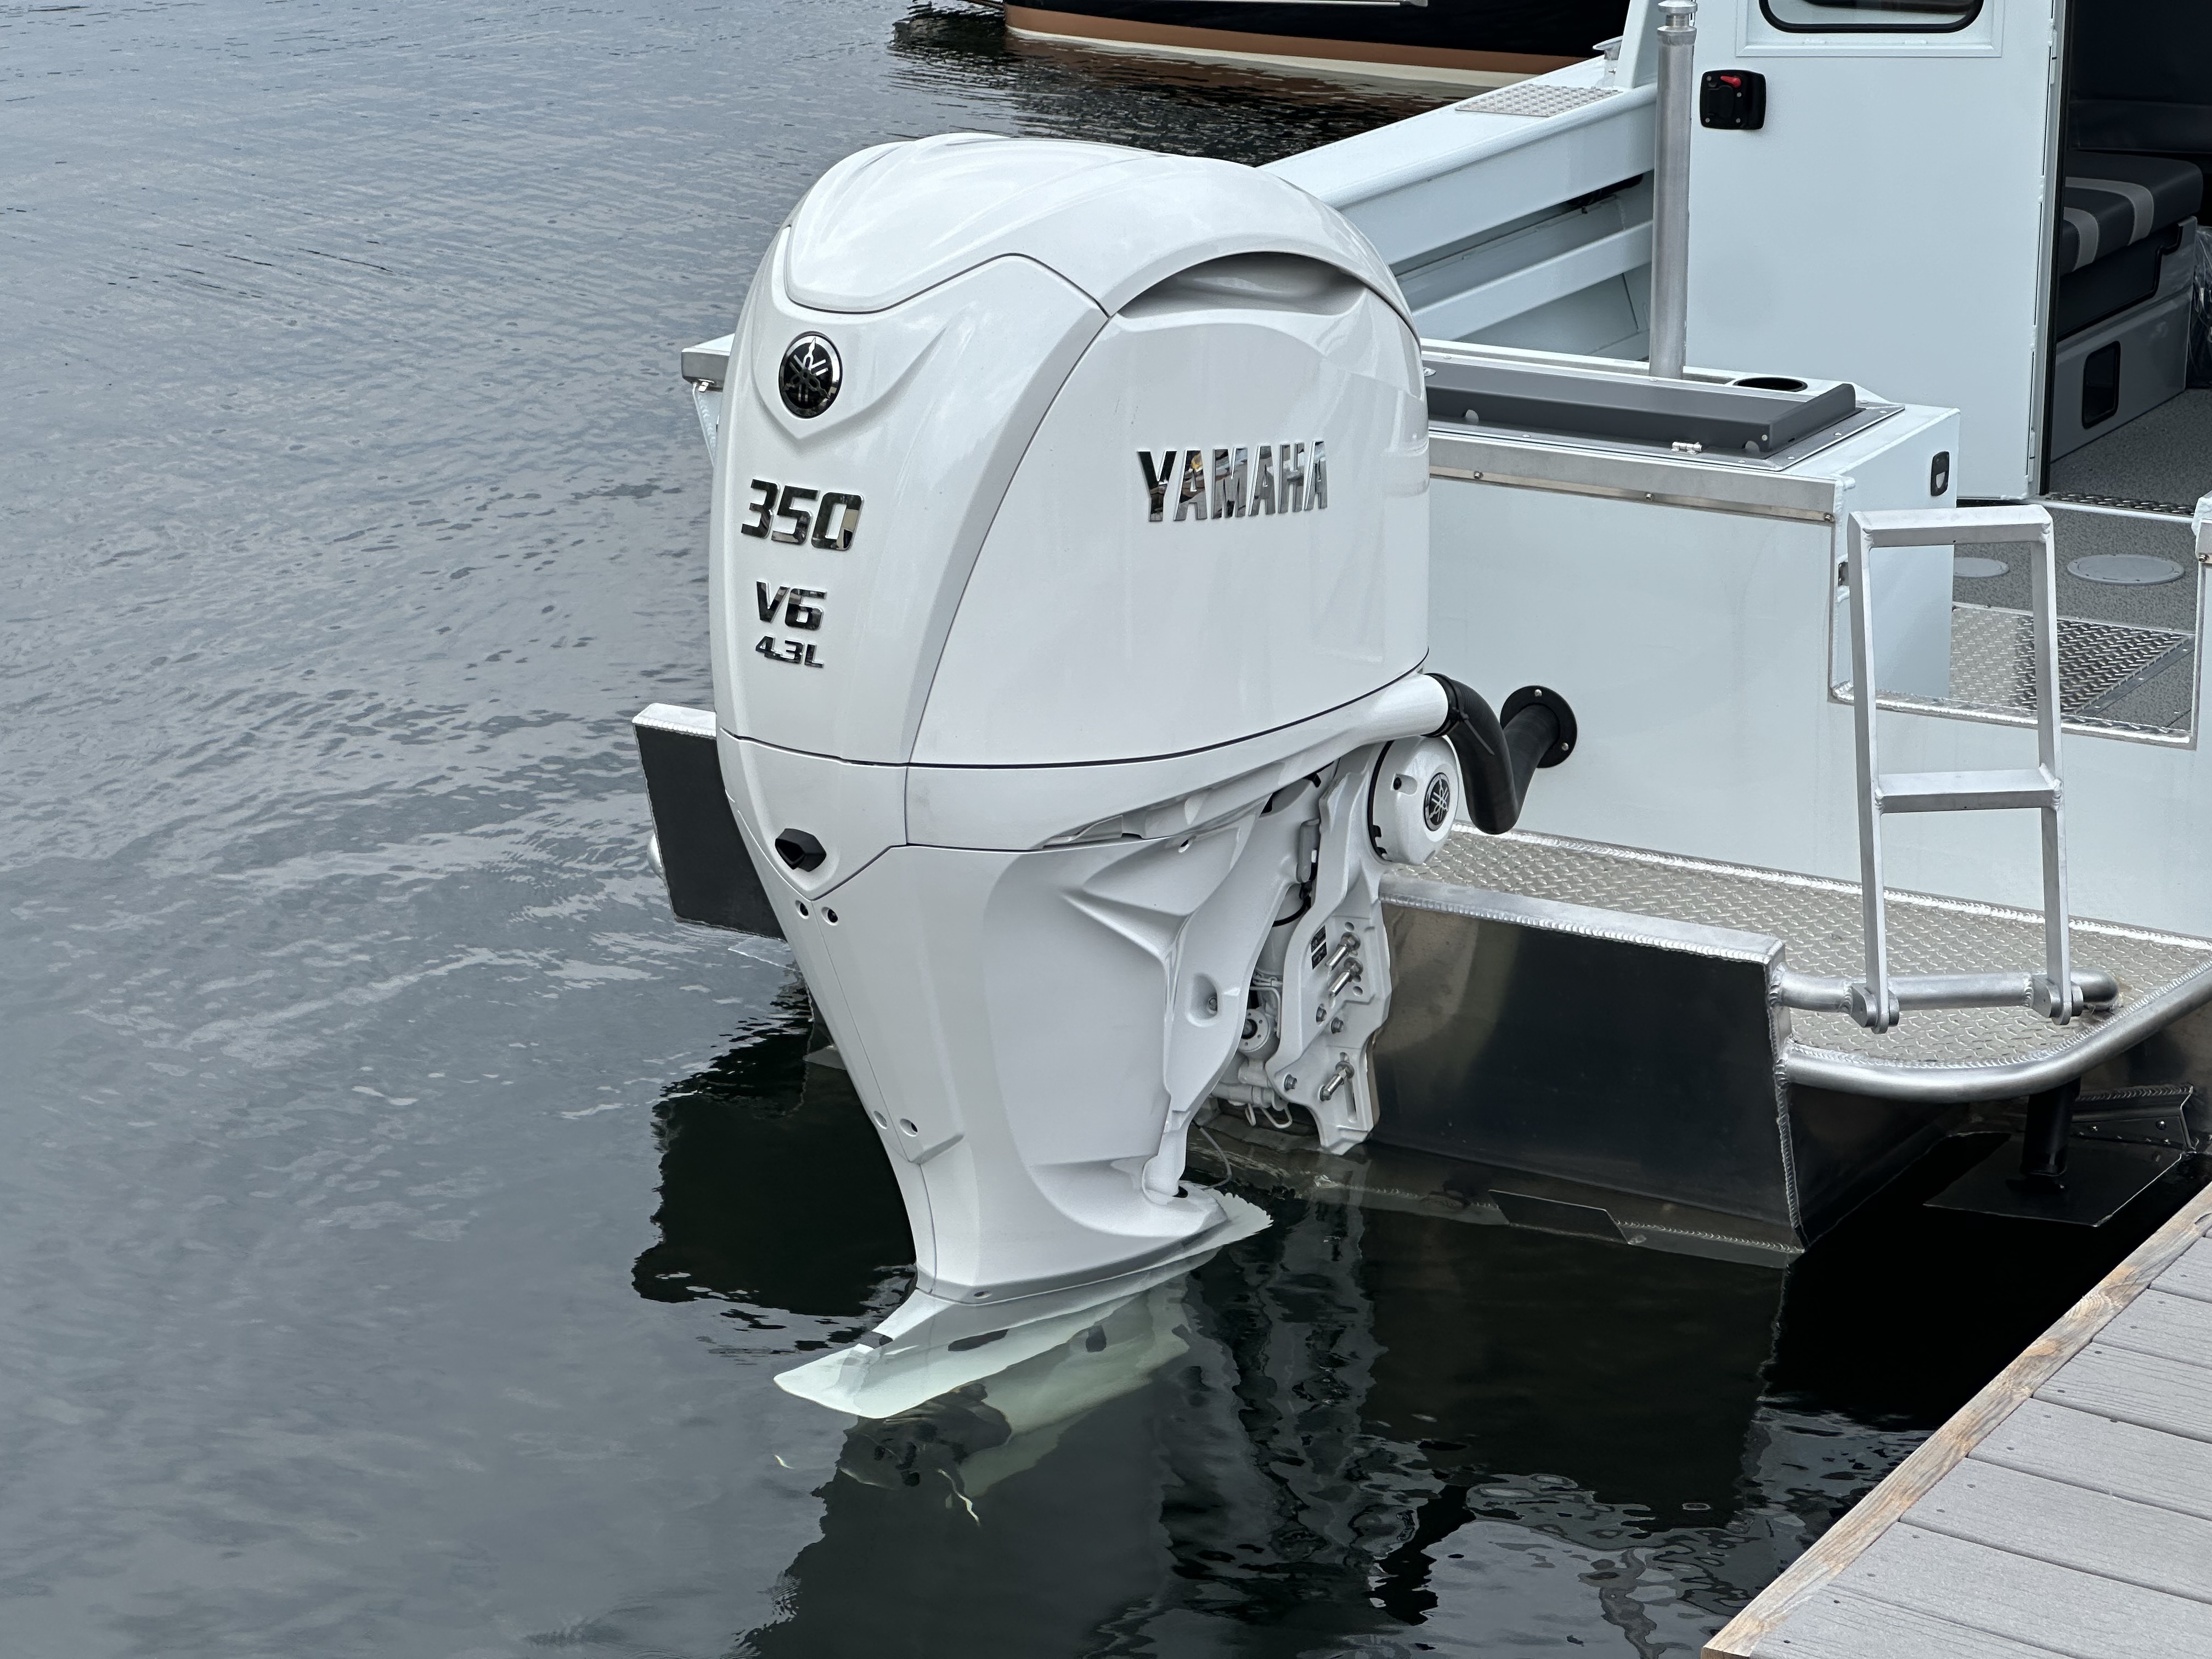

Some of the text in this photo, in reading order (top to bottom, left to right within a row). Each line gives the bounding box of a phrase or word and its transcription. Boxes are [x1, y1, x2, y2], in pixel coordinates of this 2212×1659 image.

[741, 478, 864, 551] 350
[1137, 441, 1328, 522] YAMAHA
[756, 580, 827, 631] V6
